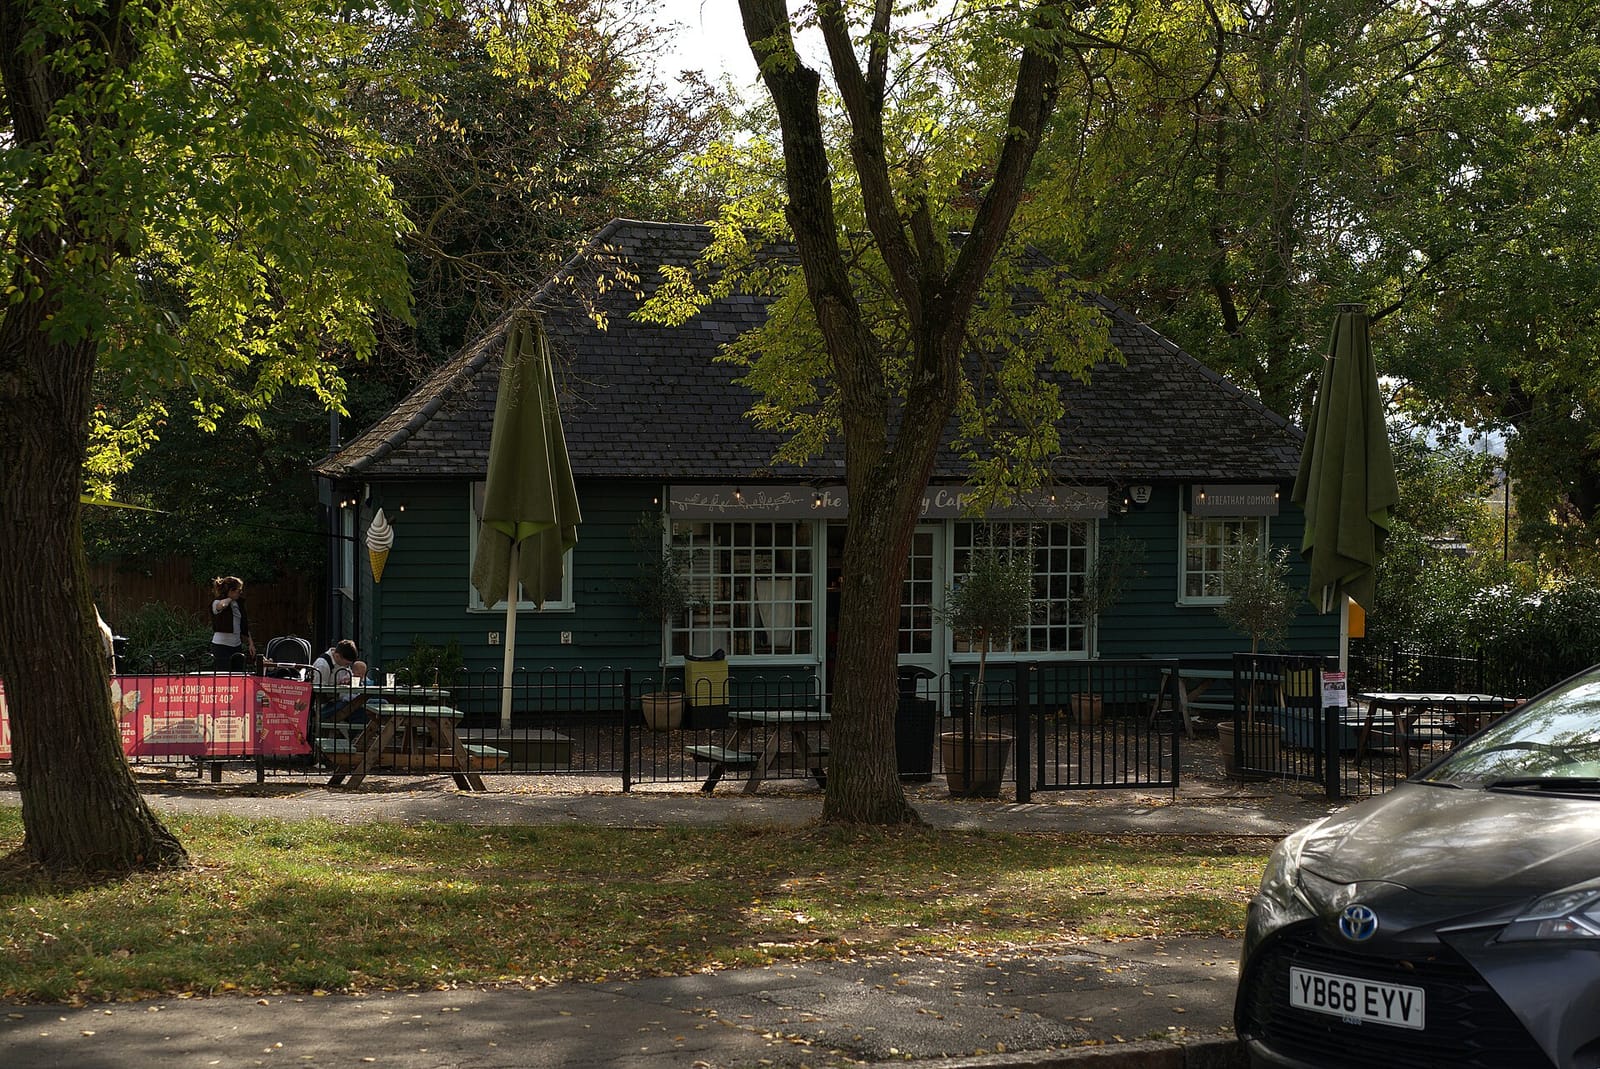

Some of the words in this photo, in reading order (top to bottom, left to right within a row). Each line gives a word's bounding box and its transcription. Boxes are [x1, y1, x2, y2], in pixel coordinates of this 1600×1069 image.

[811, 491, 842, 509] The
[1207, 495, 1245, 505] STREATHAM
[1247, 495, 1276, 505] COMMON
[153, 686, 164, 694] ADD
[165, 685, 179, 695] ANY
[181, 685, 206, 695] COMBO
[201, 694, 218, 704] JUST
[1299, 974, 1357, 1013] YB68
[1364, 985, 1413, 1022] EYV
